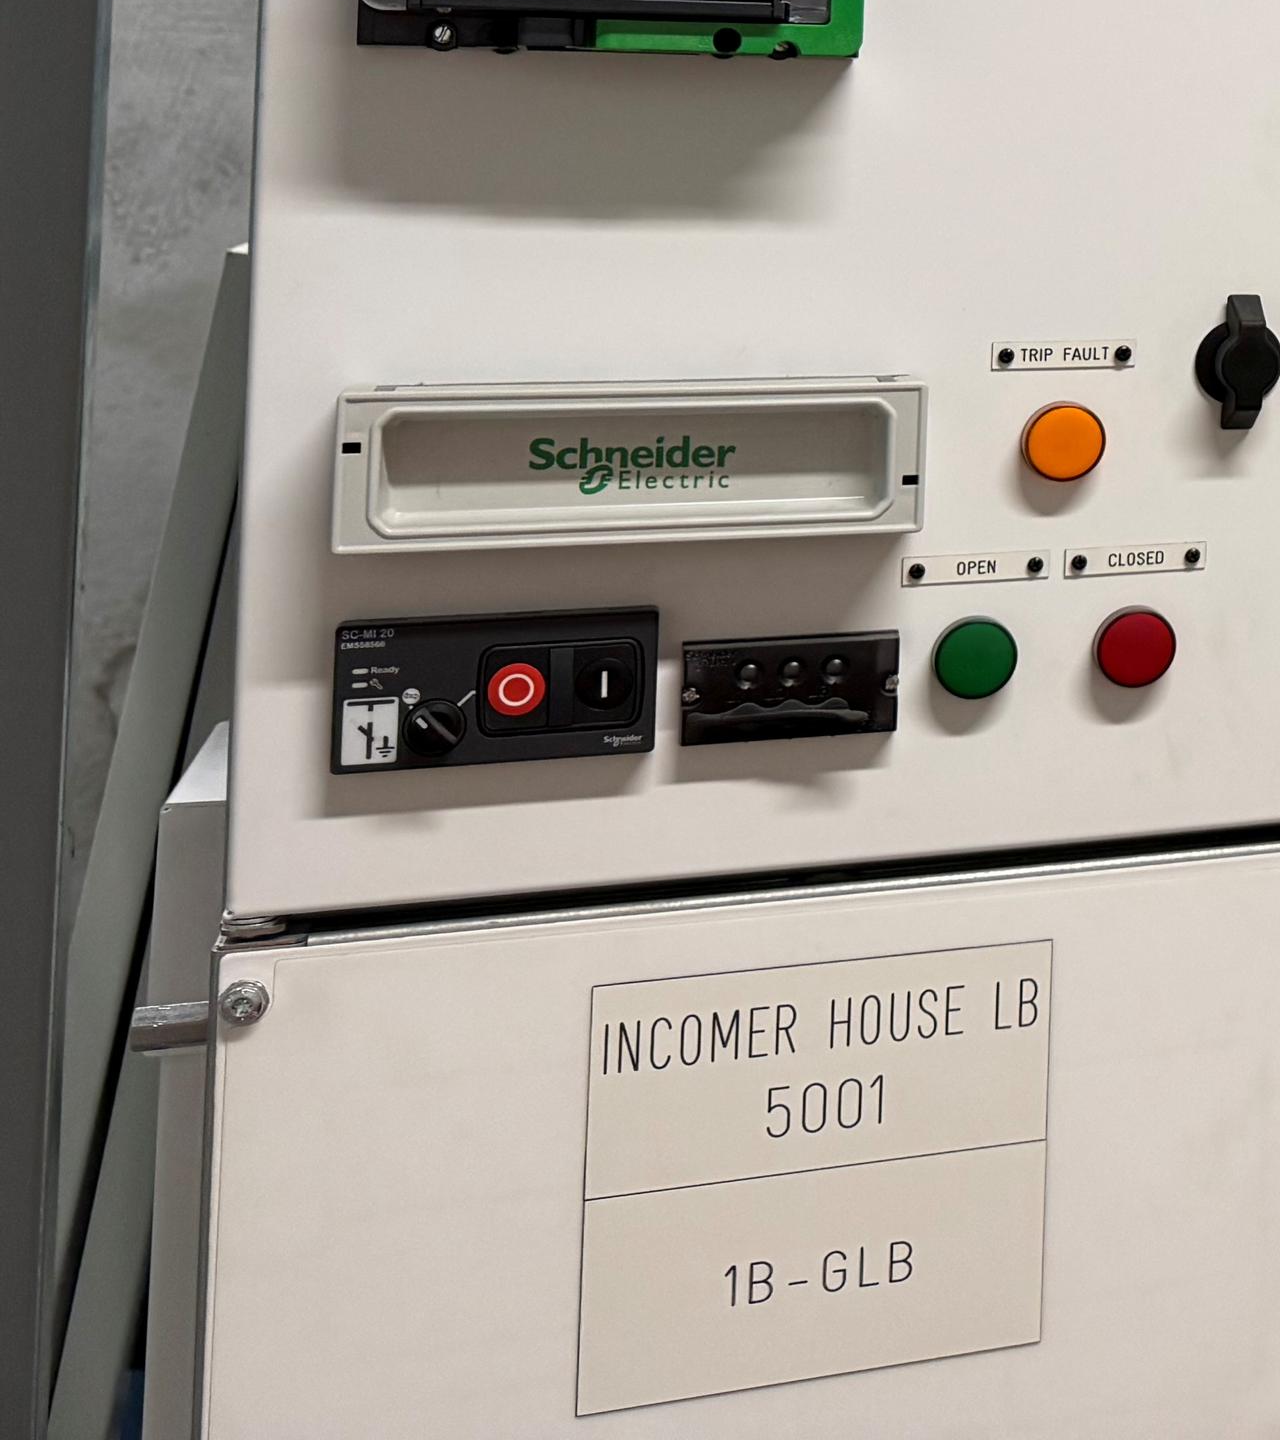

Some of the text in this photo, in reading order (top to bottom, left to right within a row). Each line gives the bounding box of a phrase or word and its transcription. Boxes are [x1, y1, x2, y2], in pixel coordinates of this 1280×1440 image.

[1021, 346, 1110, 362] TRIP FAULT
[529, 436, 736, 470] Schneider
[619, 470, 730, 490] Electric
[1108, 550, 1165, 567] CLOSED
[956, 560, 996, 576] OPEN
[341, 628, 394, 640] SC-MI 20
[371, 666, 400, 676] Ready
[602, 978, 1039, 1075] INCOMER HOUSE LB
[766, 1074, 885, 1138] 5001
